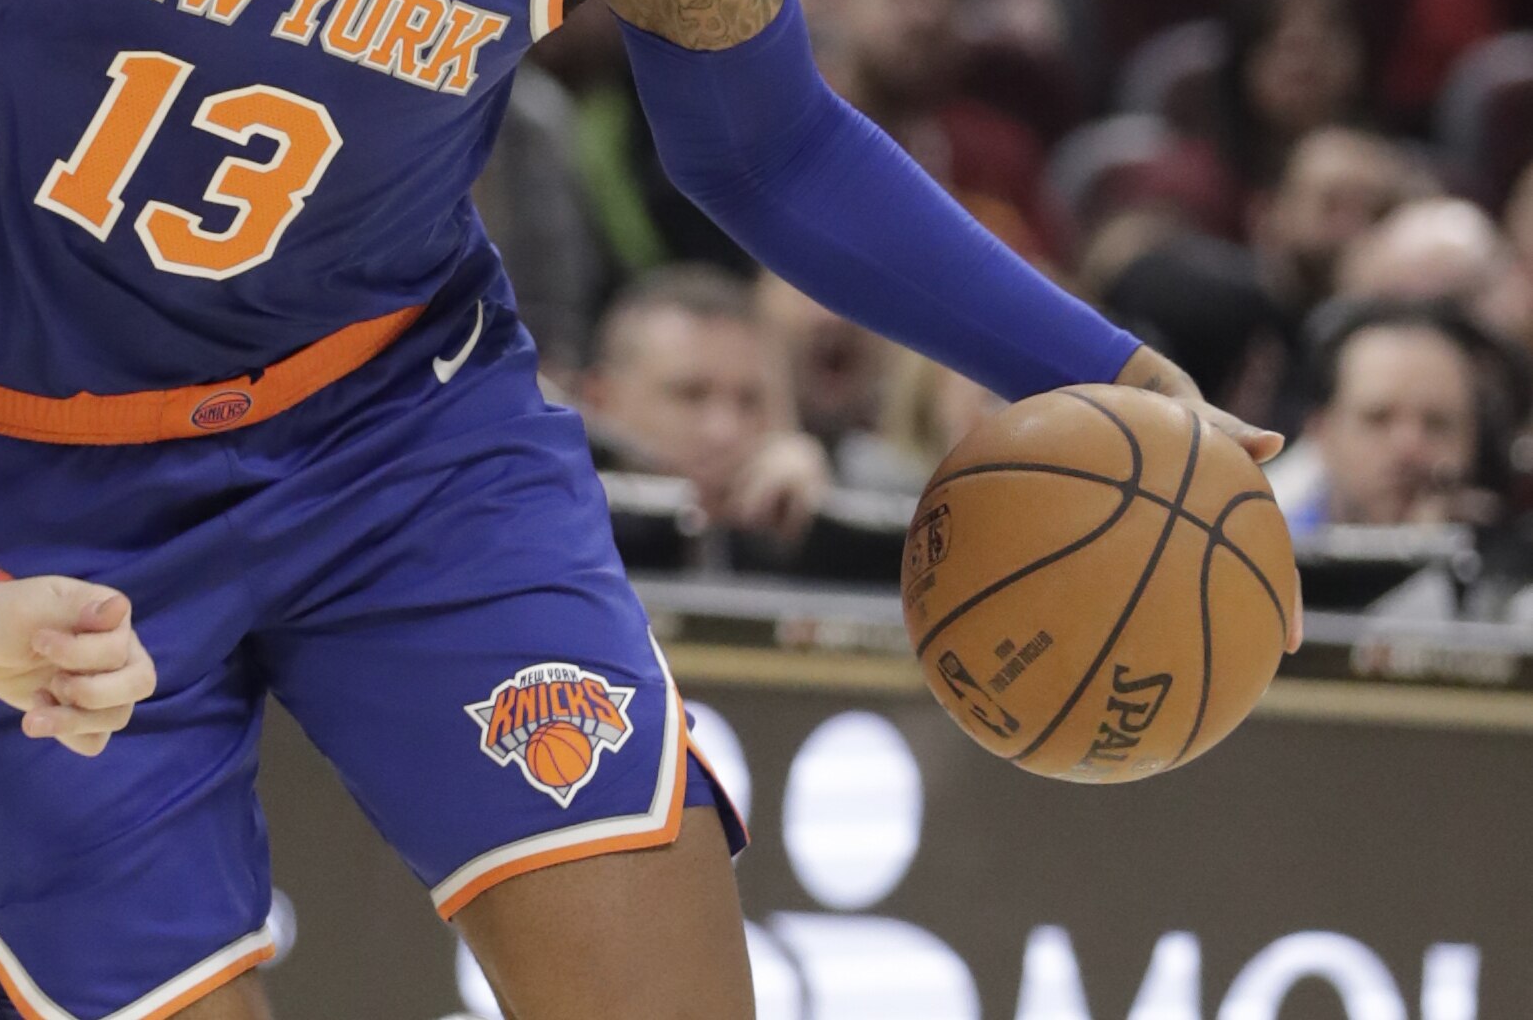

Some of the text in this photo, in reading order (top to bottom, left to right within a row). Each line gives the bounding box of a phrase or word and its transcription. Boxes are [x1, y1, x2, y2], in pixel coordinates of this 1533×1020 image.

[34, 51, 344, 281] 13
[486, 677, 628, 748] KNICKS
[519, 668, 579, 687] NEW YORK
